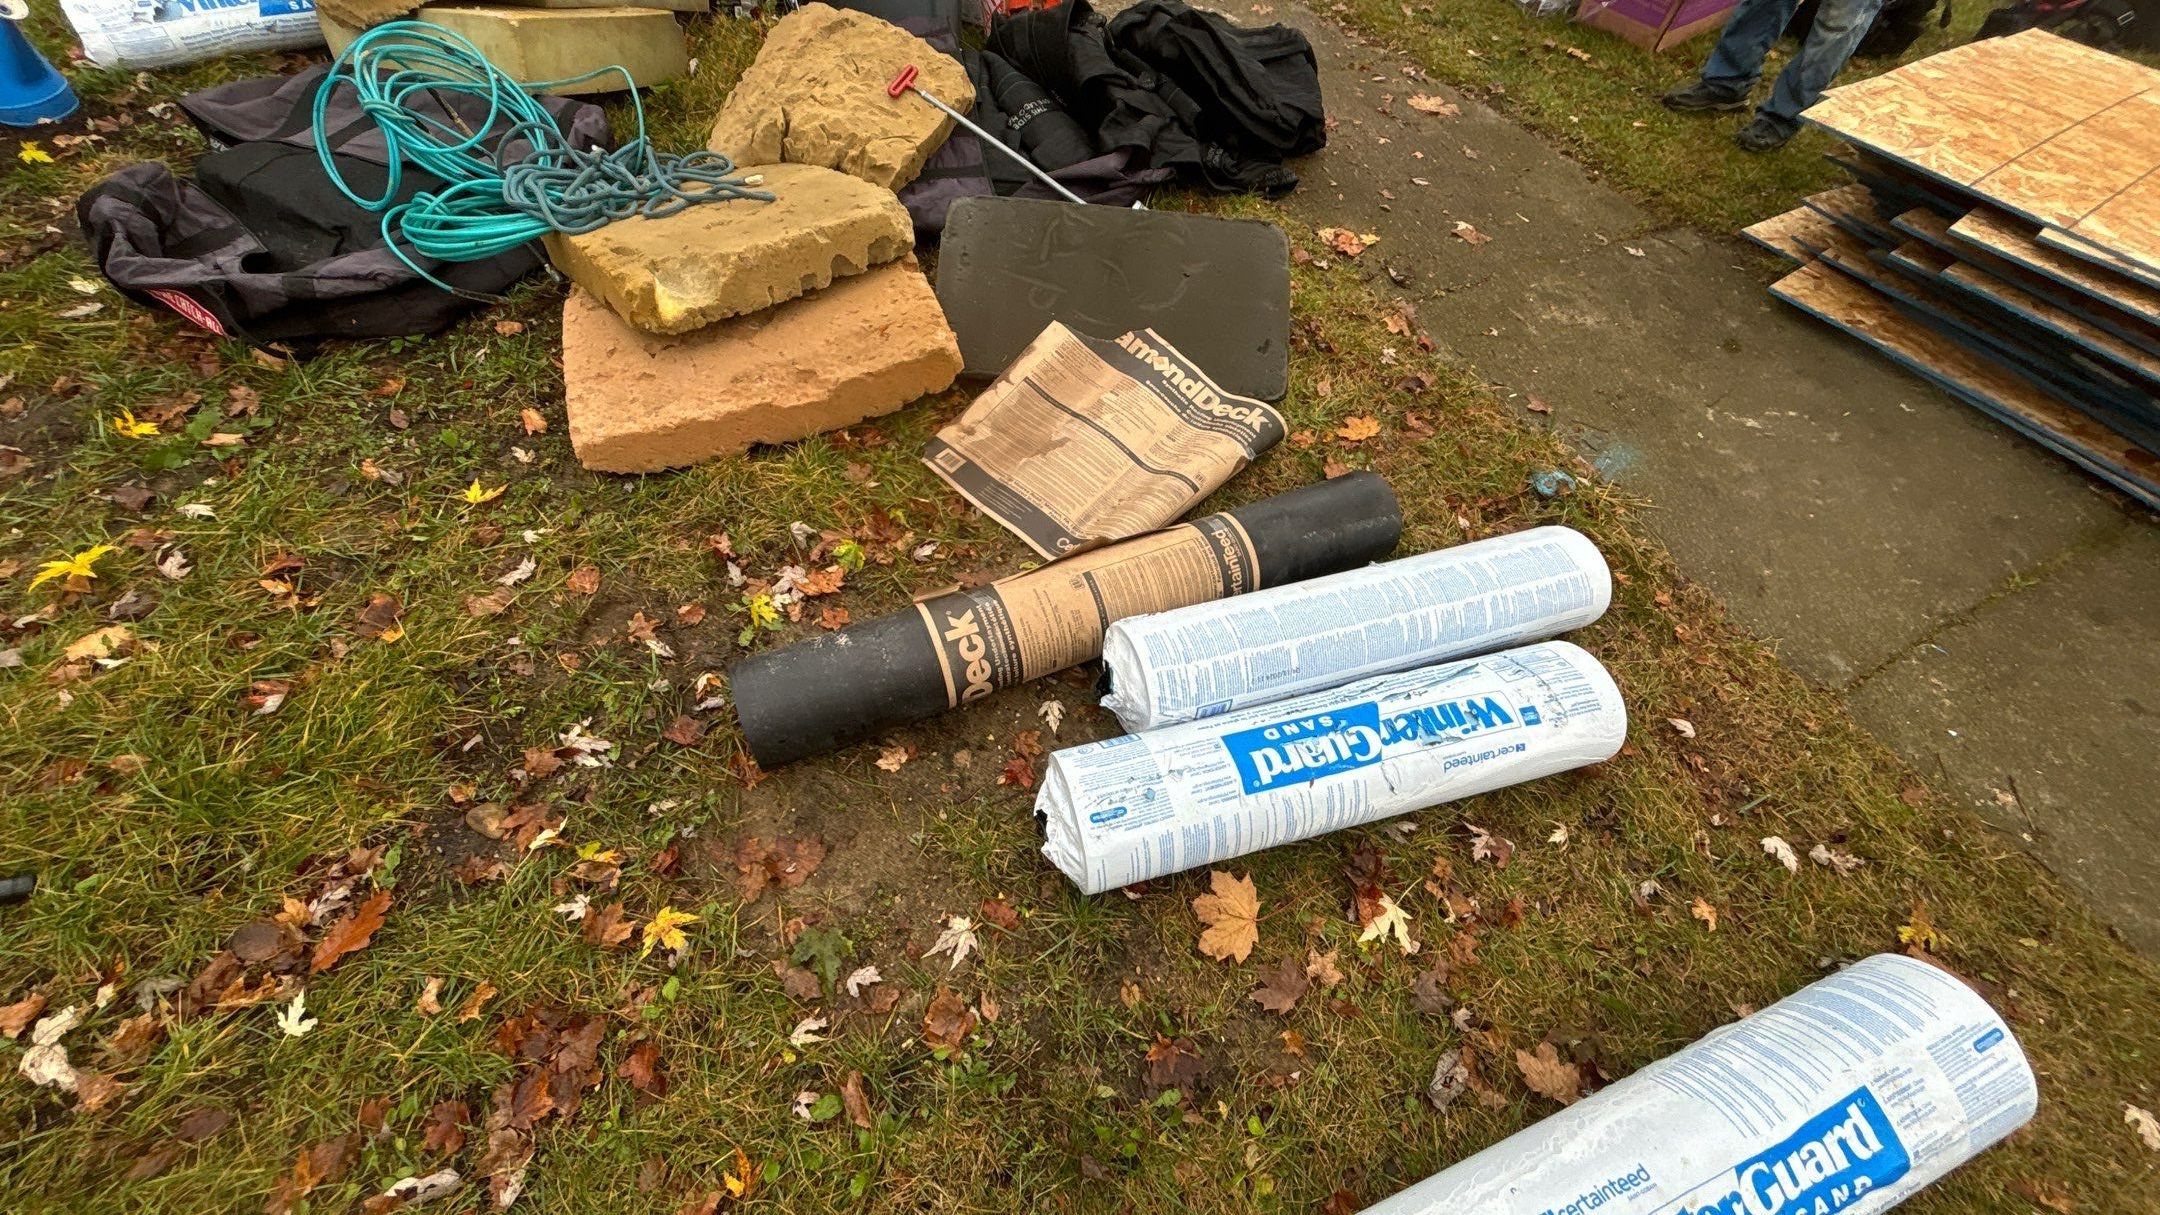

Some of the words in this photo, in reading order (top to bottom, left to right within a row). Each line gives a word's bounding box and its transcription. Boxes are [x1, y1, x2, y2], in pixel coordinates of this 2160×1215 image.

[288, 1, 313, 11] SA
[1012, 113, 1031, 130] SIDE
[1031, 104, 1048, 116] THIS
[175, 294, 224, 335] CATCH-ALL
[1211, 529, 1242, 597] ertainTeed
[1249, 696, 1514, 785] WinterGuard
[1265, 715, 1337, 741] SAND
[1444, 744, 1515, 774] certainteed
[1676, 1102, 1884, 1215] erGuard
